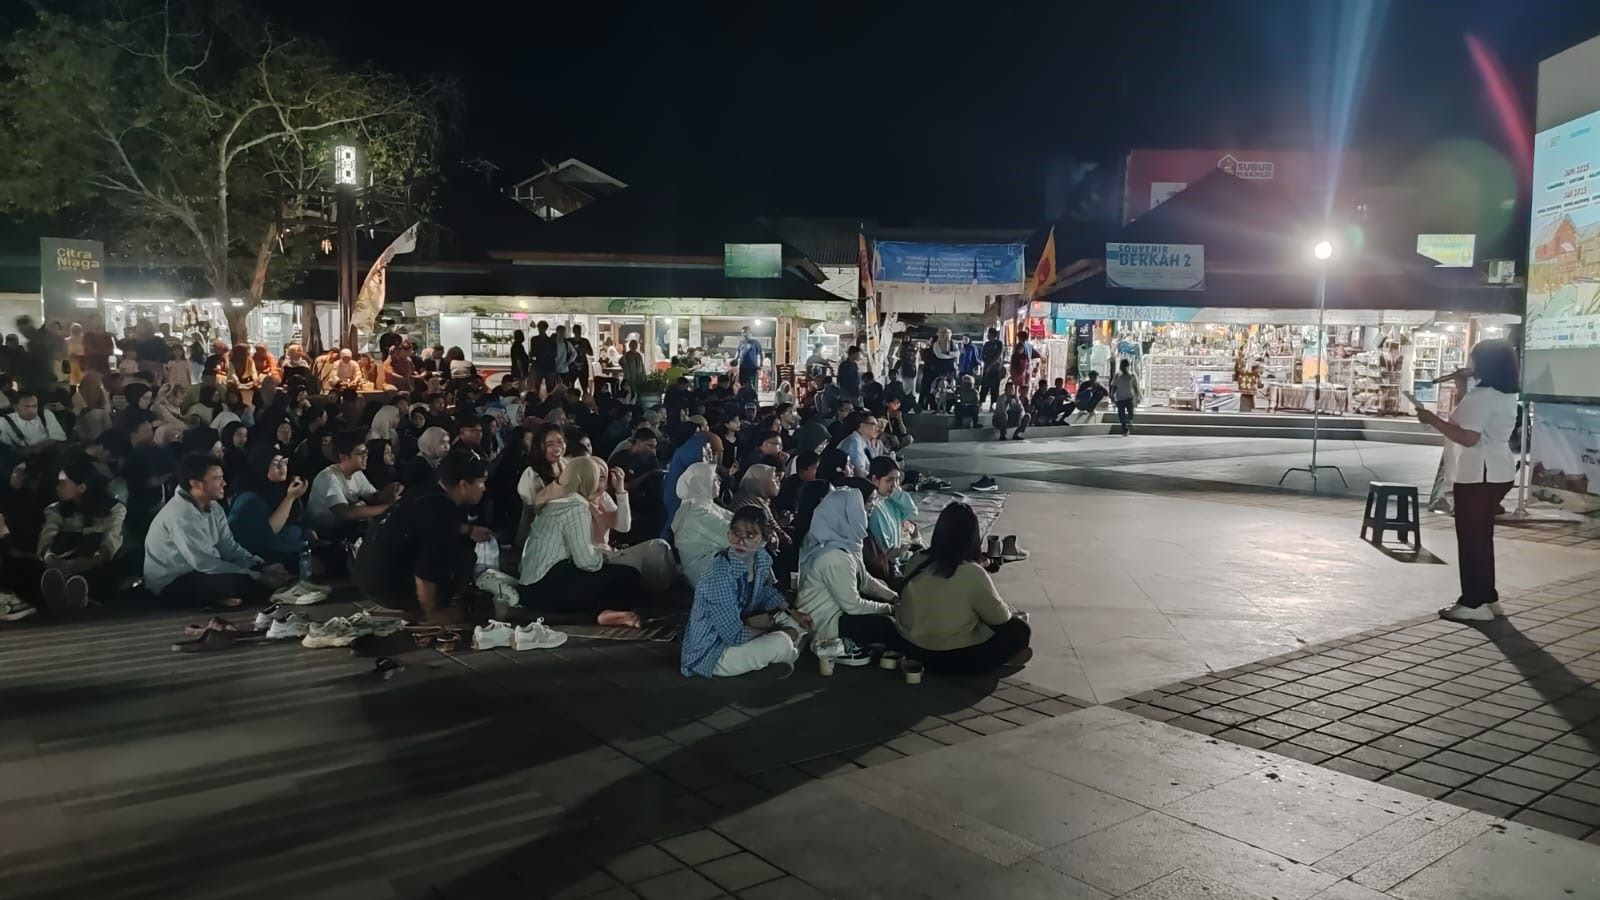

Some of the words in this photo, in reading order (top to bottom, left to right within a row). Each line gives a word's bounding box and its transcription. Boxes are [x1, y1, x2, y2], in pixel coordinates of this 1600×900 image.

[1238, 163, 1272, 171] SUBUR
[57, 248, 92, 259] Citra
[1118, 245, 1169, 254] SOUVENIR
[57, 256, 100, 270] Niaga
[1119, 253, 1180, 267] BERKAH
[1184, 254, 1192, 267] 2
[1106, 306, 1163, 320] BERKAH
